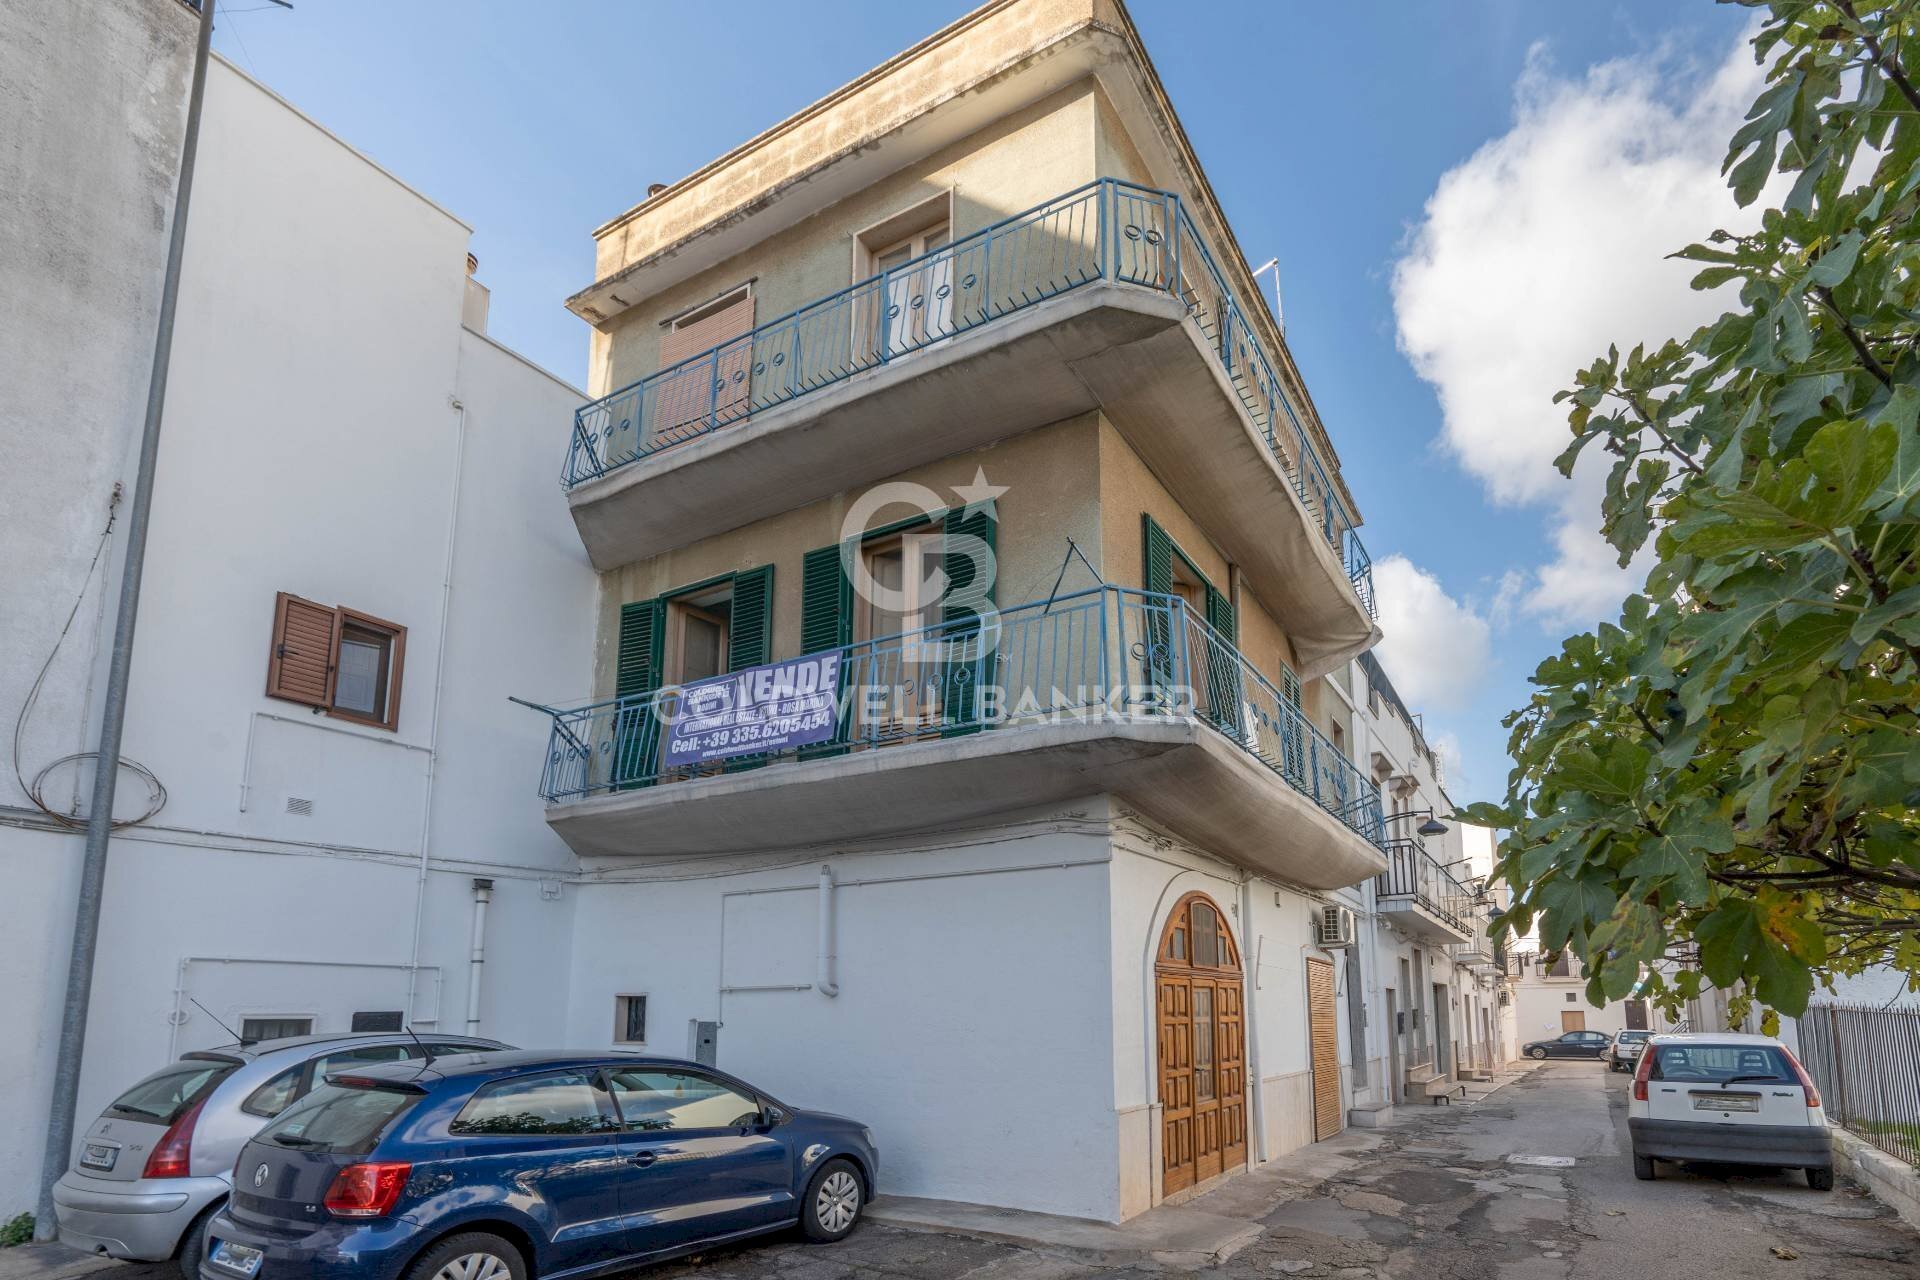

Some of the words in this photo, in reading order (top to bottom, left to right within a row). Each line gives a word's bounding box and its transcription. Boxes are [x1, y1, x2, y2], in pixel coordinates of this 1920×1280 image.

[738, 656, 839, 707] VENDE
[672, 736, 700, 754] Cell:
[703, 730, 730, 748] +39
[731, 711, 831, 744] 335.6205454
